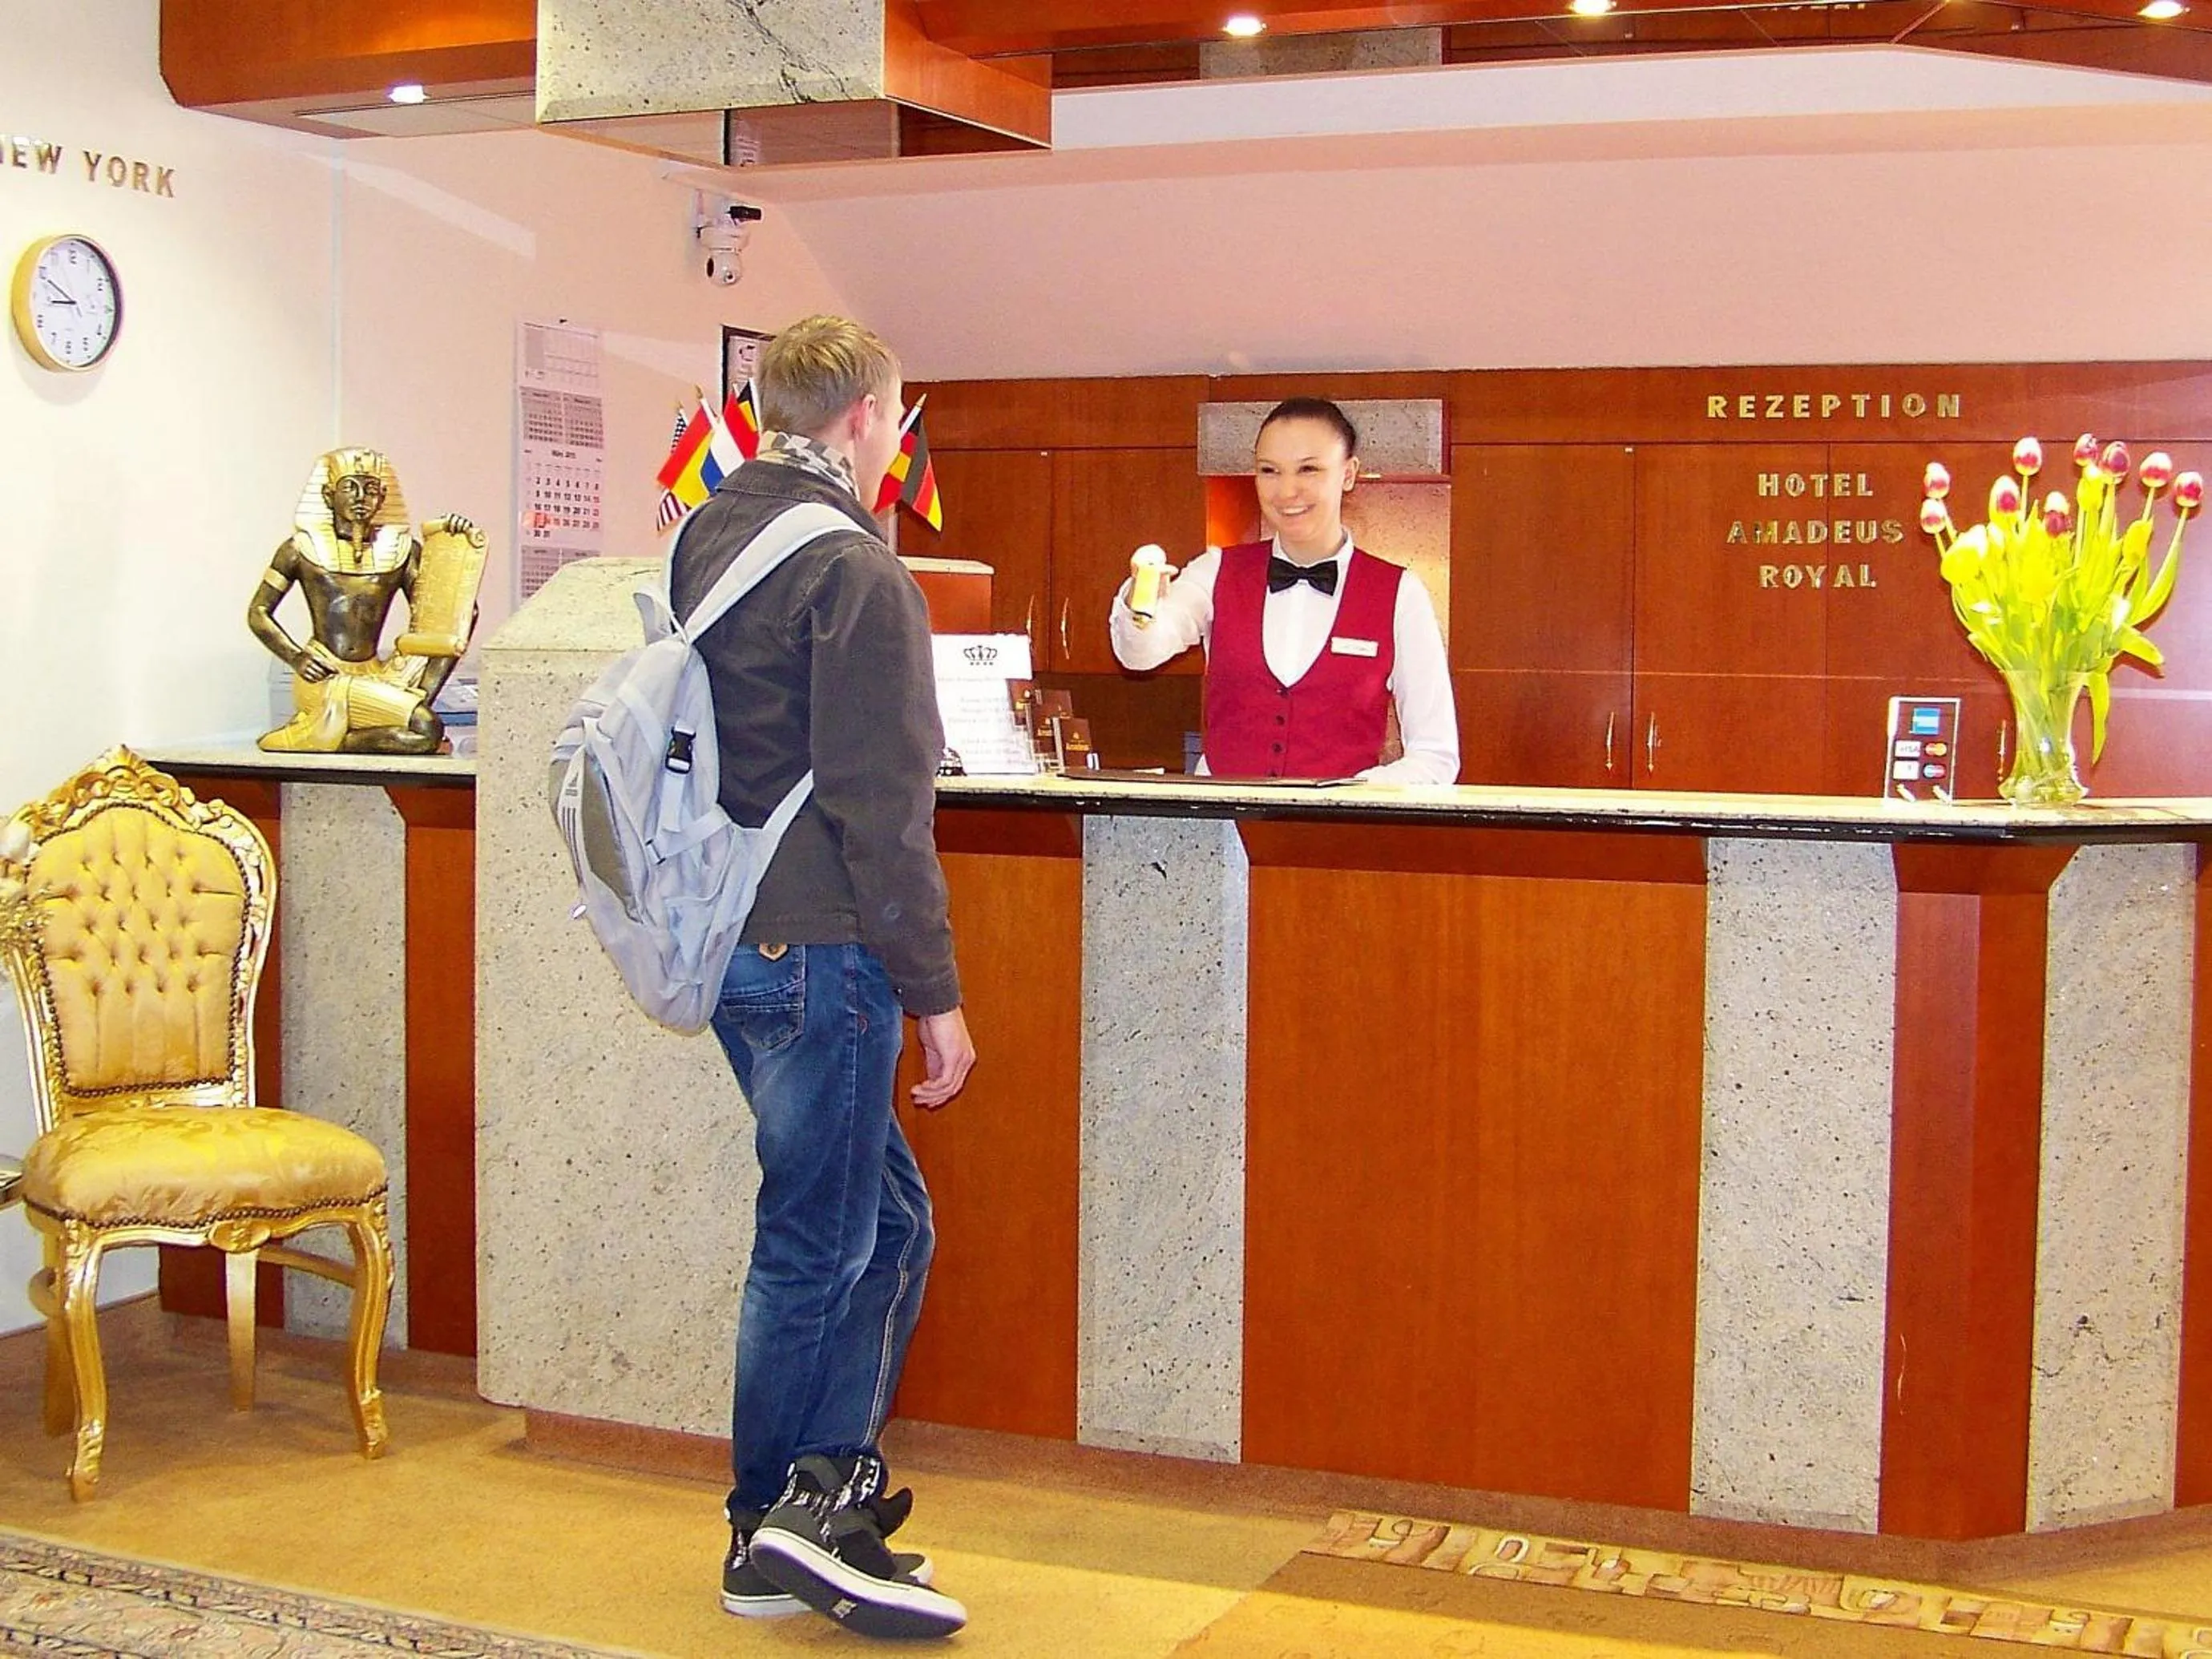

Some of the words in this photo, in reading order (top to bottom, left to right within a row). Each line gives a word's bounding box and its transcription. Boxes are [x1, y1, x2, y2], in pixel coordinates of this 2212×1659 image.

[0, 135, 63, 174] EW
[82, 148, 175, 198] YORK
[1707, 394, 1961, 418] REZEPTION
[1758, 473, 1873, 497] HOTEL
[1727, 520, 1904, 544] AMADEUS
[1759, 564, 1877, 588] ROYAL
